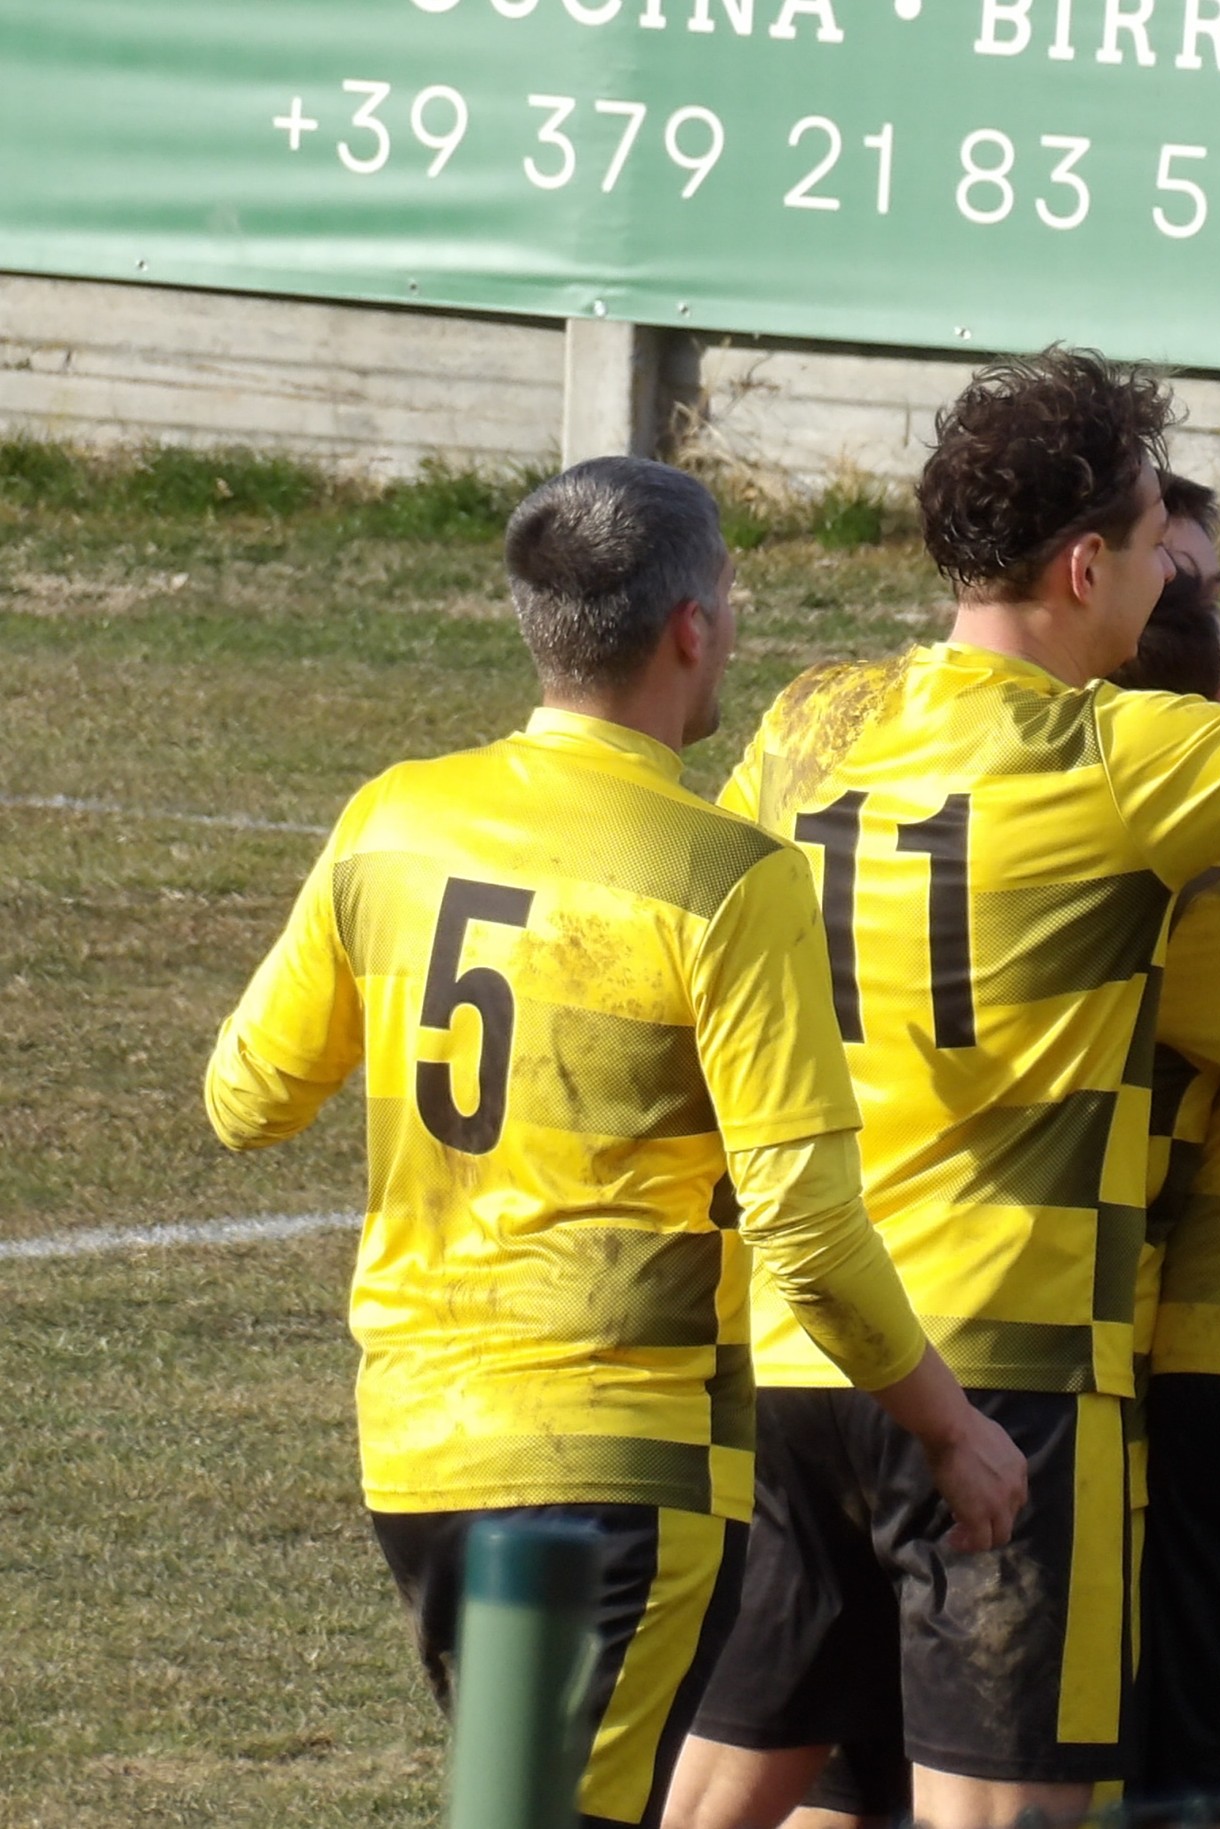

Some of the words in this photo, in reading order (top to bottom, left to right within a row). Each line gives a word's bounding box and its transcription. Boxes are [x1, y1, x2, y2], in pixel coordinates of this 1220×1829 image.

[273, 80, 468, 178] +39
[524, 94, 724, 198] 379
[784, 116, 892, 213] 21
[956, 129, 1090, 229] 83
[415, 876, 537, 1156] 5
[794, 789, 976, 1049] 11
